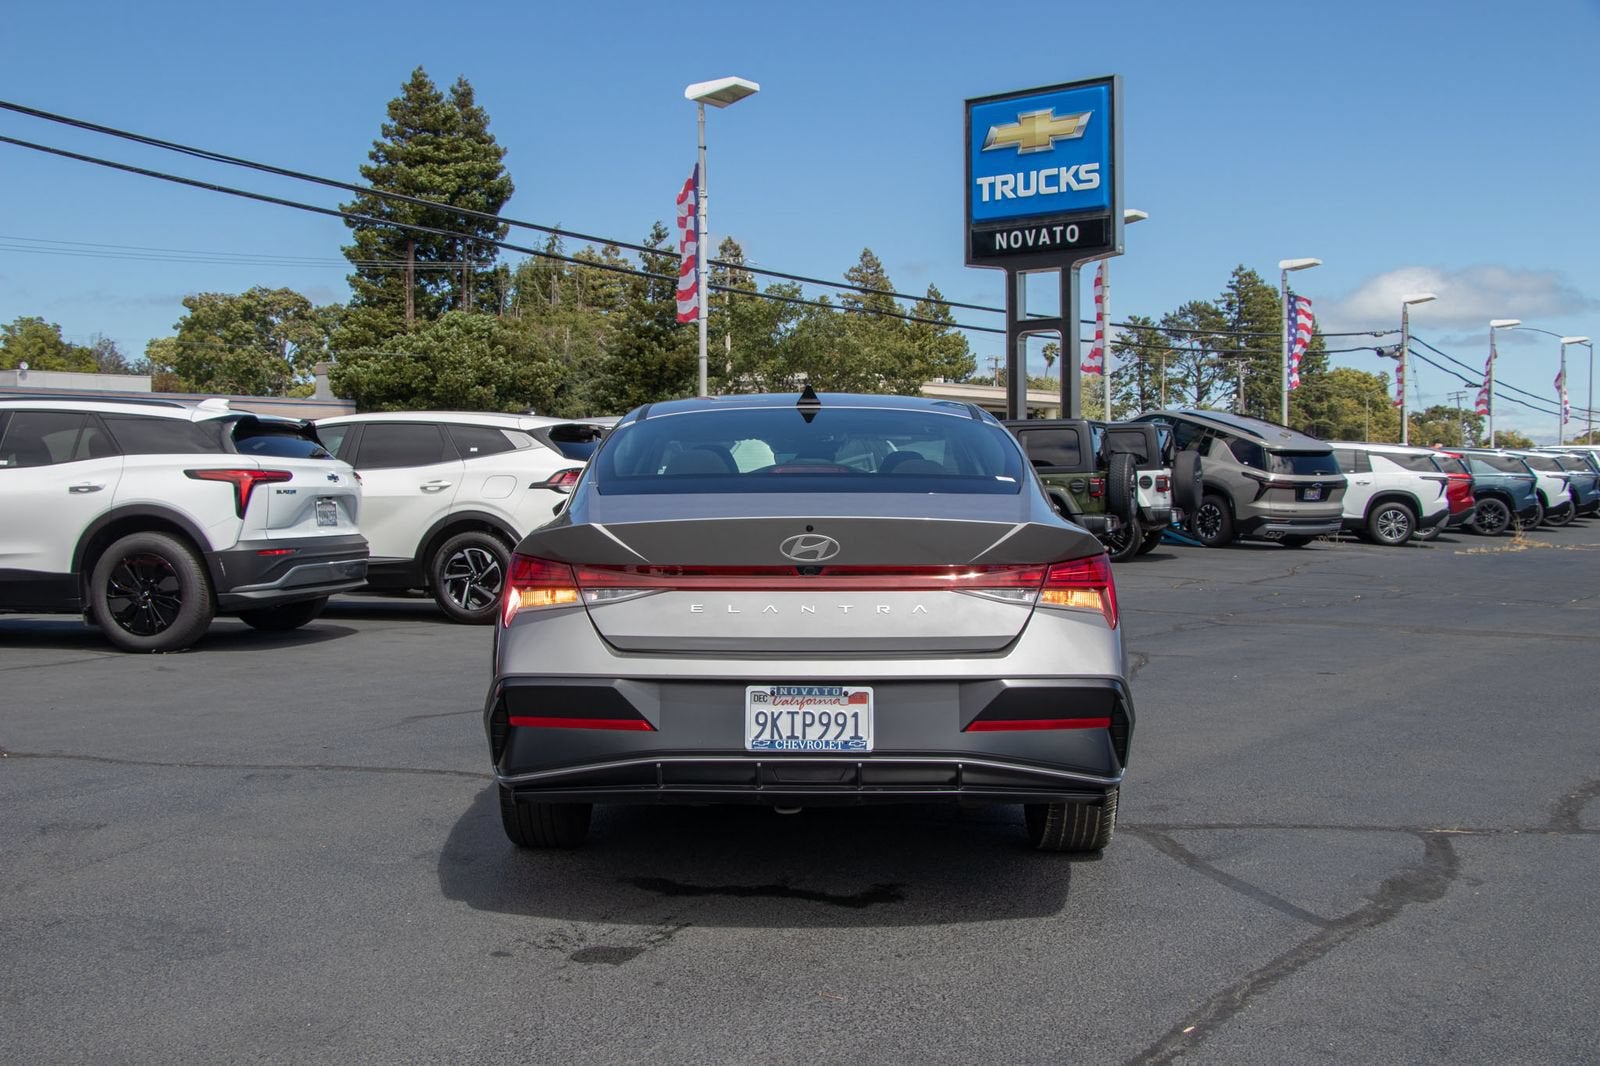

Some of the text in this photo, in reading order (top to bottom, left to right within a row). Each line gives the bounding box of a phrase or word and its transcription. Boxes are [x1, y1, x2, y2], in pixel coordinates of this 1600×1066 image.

[976, 162, 1100, 202] TRUCKS
[995, 224, 1080, 250] NOVATO
[690, 604, 928, 614] ELANTRA
[780, 687, 840, 695] NOVATO
[753, 694, 768, 702] DEC
[771, 695, 842, 710] California
[754, 711, 863, 739] 9KIP991
[775, 740, 844, 749] CHEVROLET
